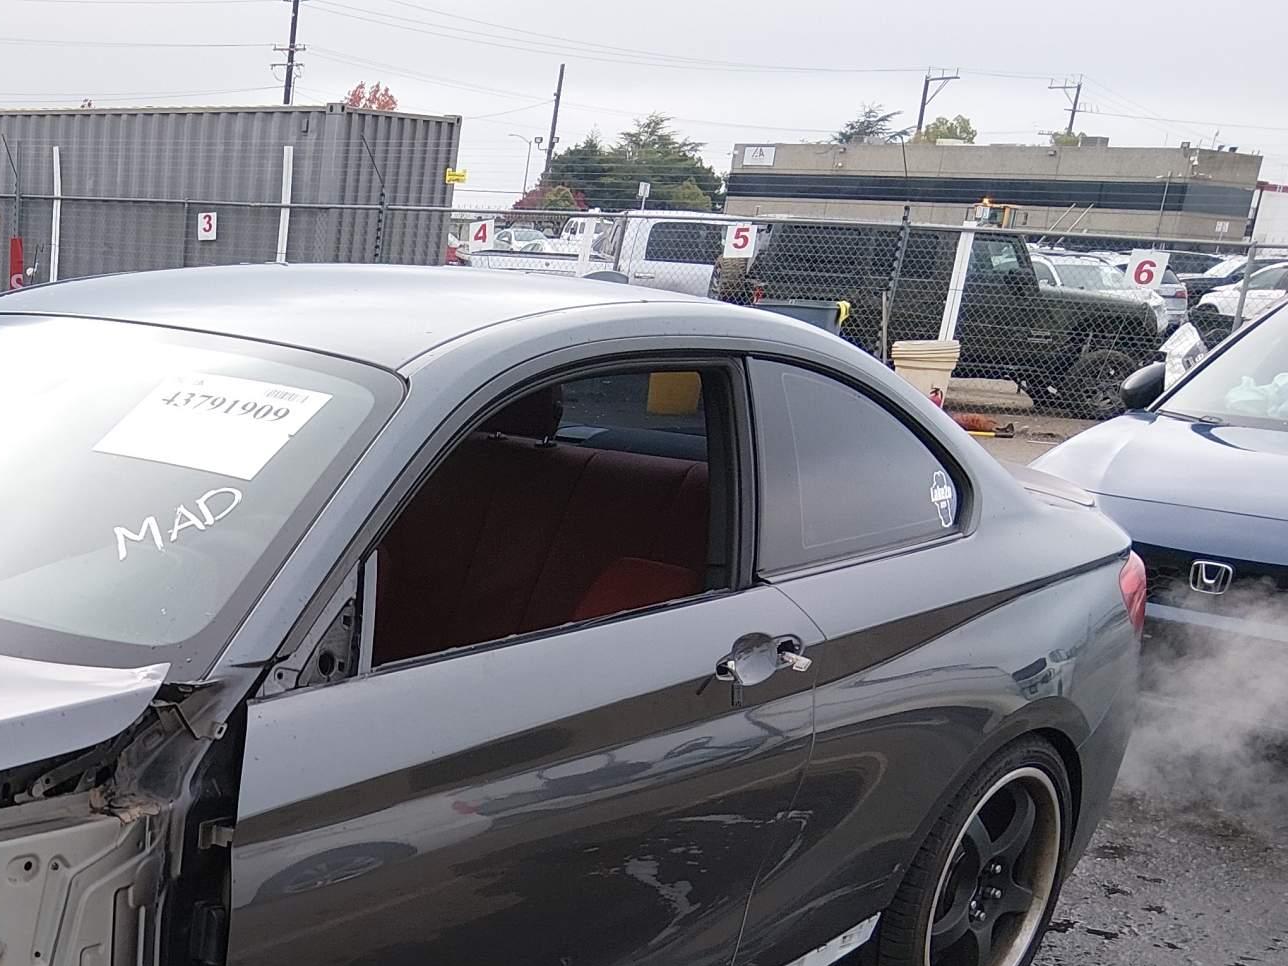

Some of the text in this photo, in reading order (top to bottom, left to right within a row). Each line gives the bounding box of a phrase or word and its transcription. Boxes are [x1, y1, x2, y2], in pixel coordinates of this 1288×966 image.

[202, 214, 213, 233] 3
[473, 223, 487, 243] 4
[732, 227, 750, 250] 5
[1133, 259, 1157, 285] 6
[162, 391, 290, 422] 43791909
[114, 487, 242, 561] MAD
